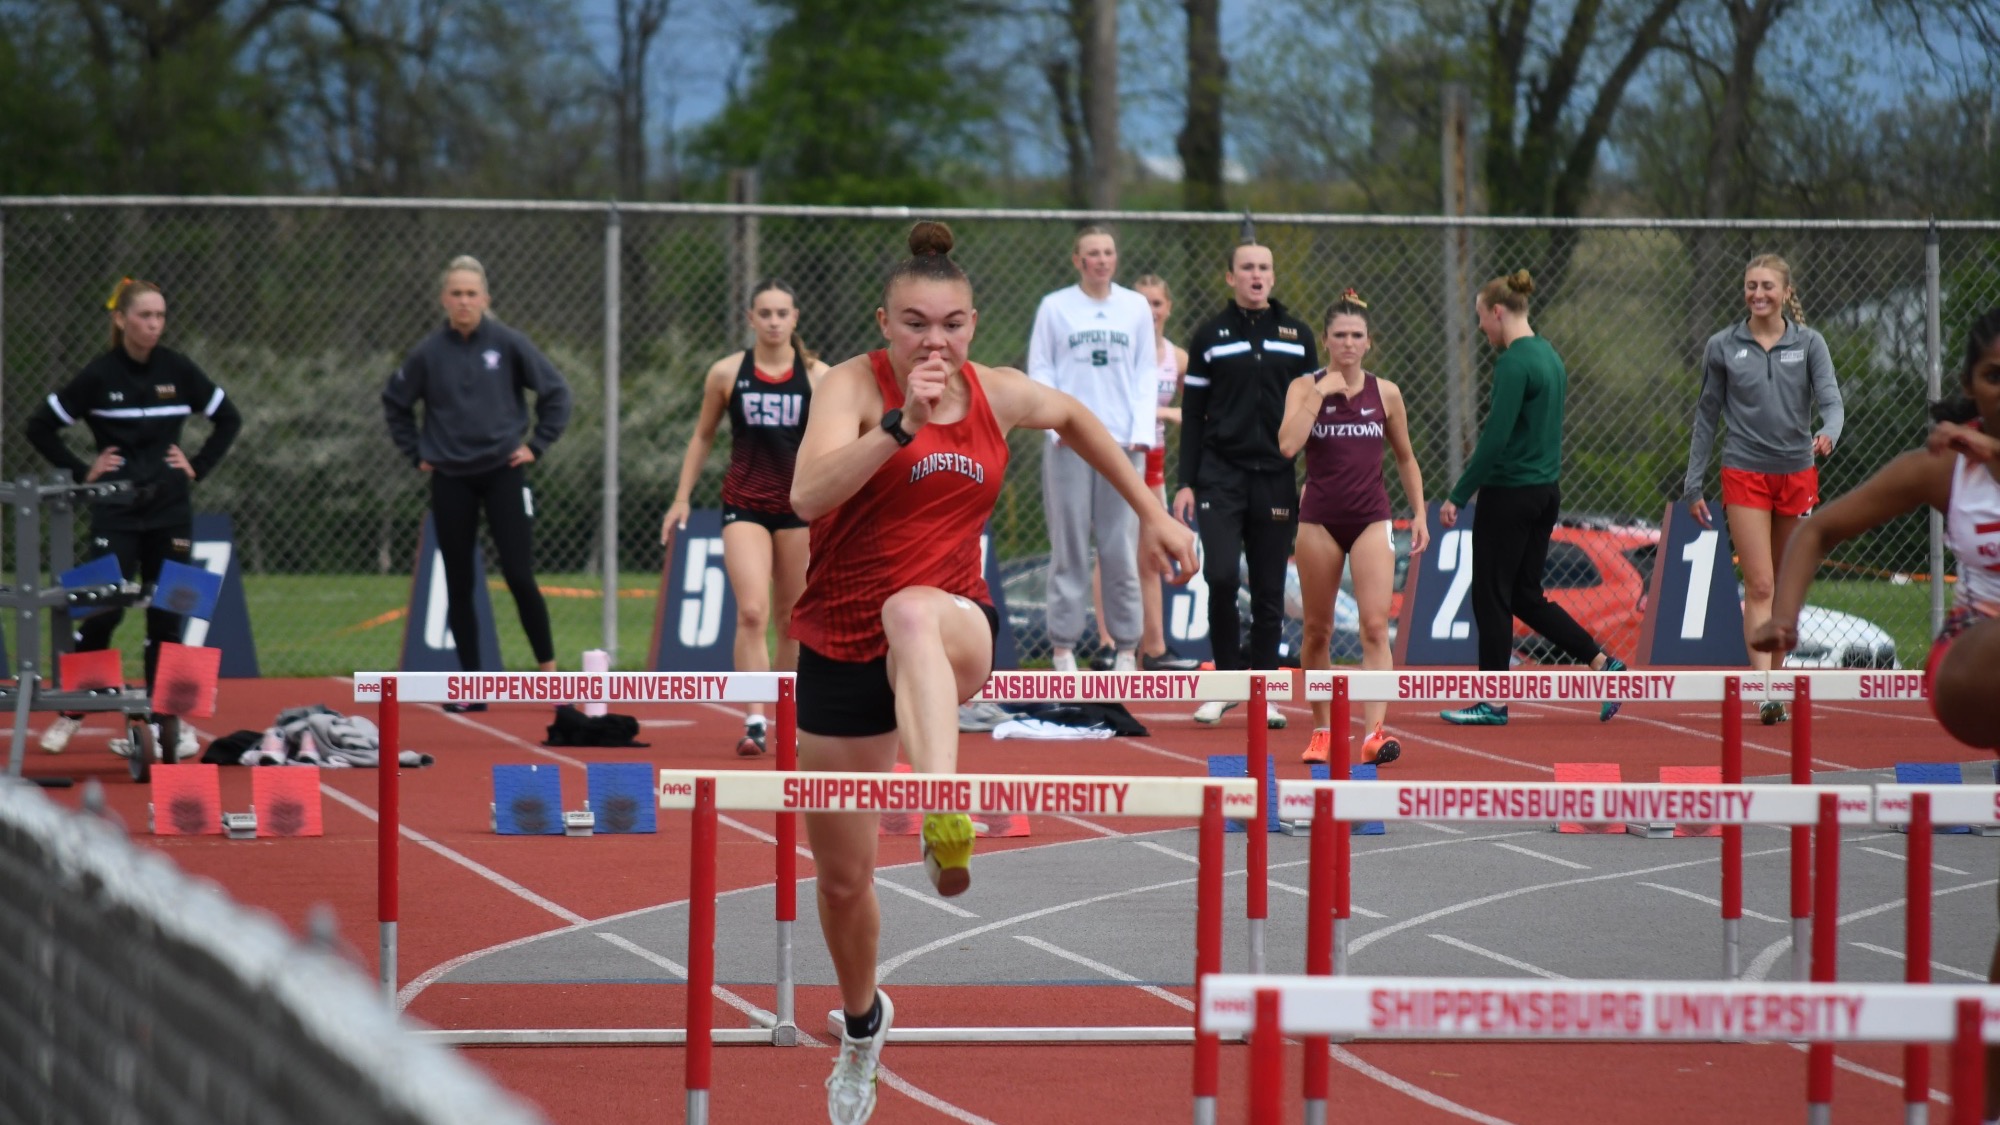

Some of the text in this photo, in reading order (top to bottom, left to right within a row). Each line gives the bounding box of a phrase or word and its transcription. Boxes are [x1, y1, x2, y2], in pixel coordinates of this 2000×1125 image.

[1091, 350, 1108, 367] S
[742, 393, 803, 426] ESU
[1312, 422, 1384, 438] KUTZTOWN
[909, 452, 985, 485] MANSFIELD
[679, 538, 725, 647] 5
[1431, 530, 1473, 638] 2
[1681, 530, 1719, 639] 1
[447, 676, 729, 700] SHIPPENSBURG UNIVERSITY
[982, 675, 1200, 699] ENSBURG UNIVERSITY
[1398, 675, 1676, 699] SHIPPENSBURG UNIVERSITY
[783, 777, 1130, 813] SHIPPENSBURG UNIVERSITY
[1398, 788, 1754, 820] SHIPPENSBURG UNIVERSITY
[1370, 988, 1865, 1036] SHIPPENSBURG UNIVERSITY
